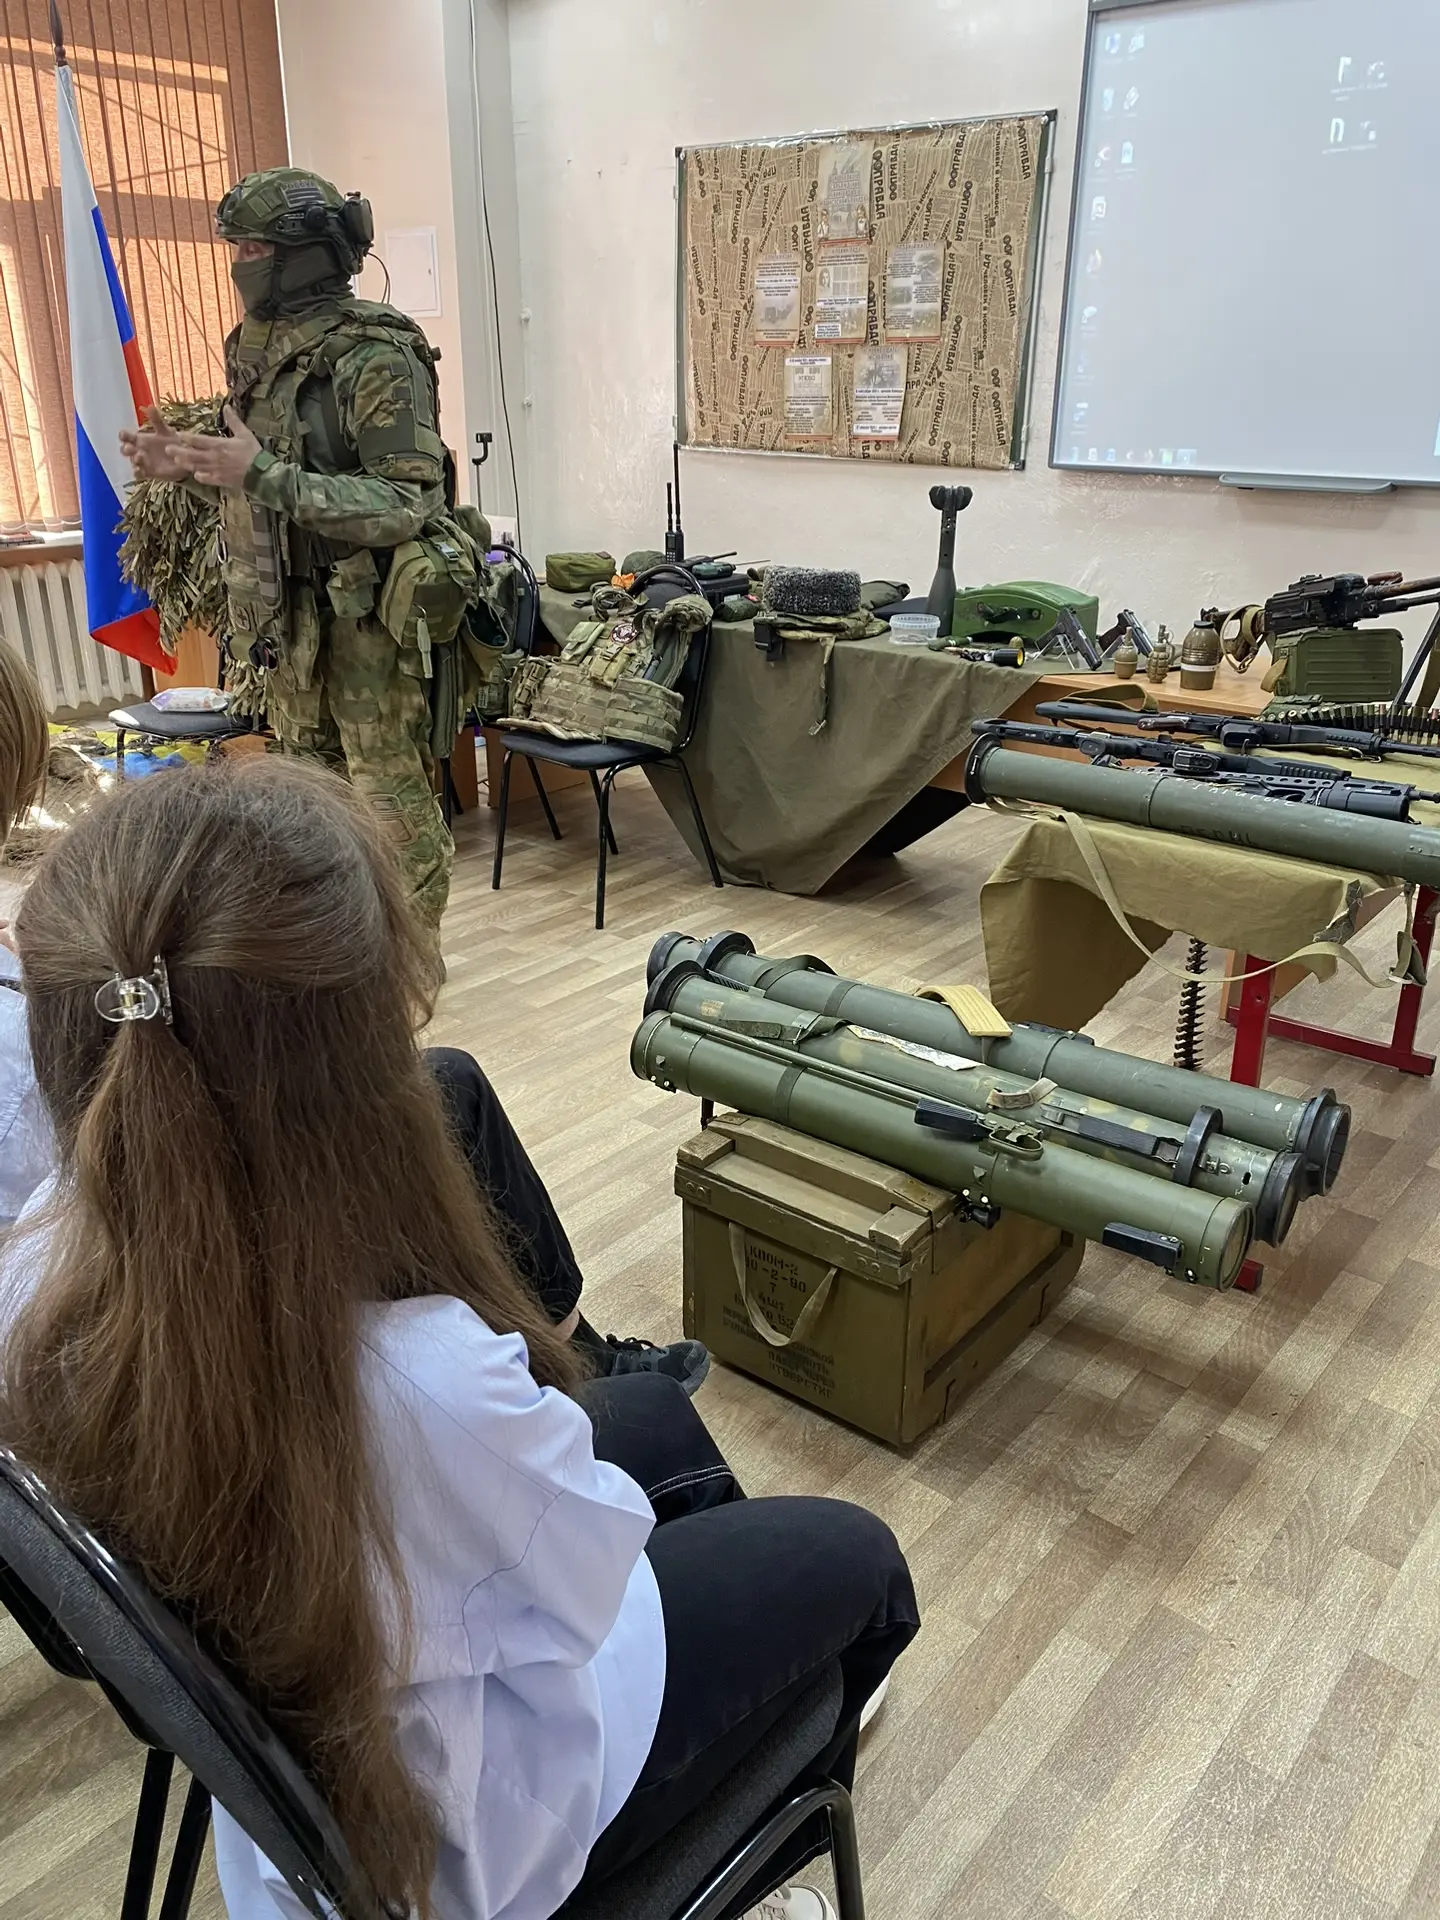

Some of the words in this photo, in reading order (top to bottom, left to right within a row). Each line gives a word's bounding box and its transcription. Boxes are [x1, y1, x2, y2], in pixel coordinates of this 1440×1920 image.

[874, 172, 885, 219] ПРАВДА
[801, 206, 812, 253] ПРАВДА
[955, 199, 969, 241] ПРАВДА
[868, 302, 879, 347] ПРАВДА
[945, 332, 959, 371] ПРАВДА
[933, 392, 945, 430] ПРАВДА
